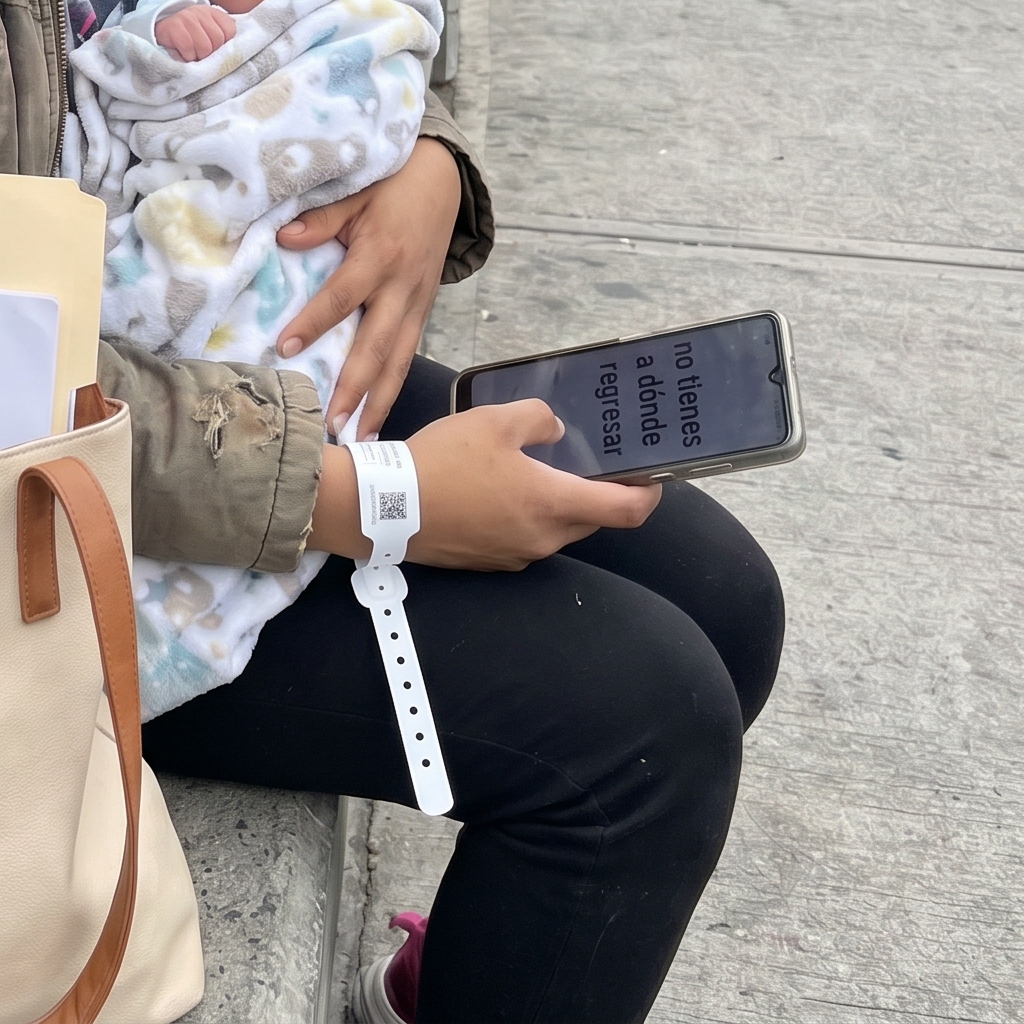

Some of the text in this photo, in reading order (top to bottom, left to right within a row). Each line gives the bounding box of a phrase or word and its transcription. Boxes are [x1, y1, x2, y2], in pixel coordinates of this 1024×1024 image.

[595, 362, 622, 456] regresar
[636, 355, 667, 446] a dónde
[674, 341, 702, 448] no tienes
